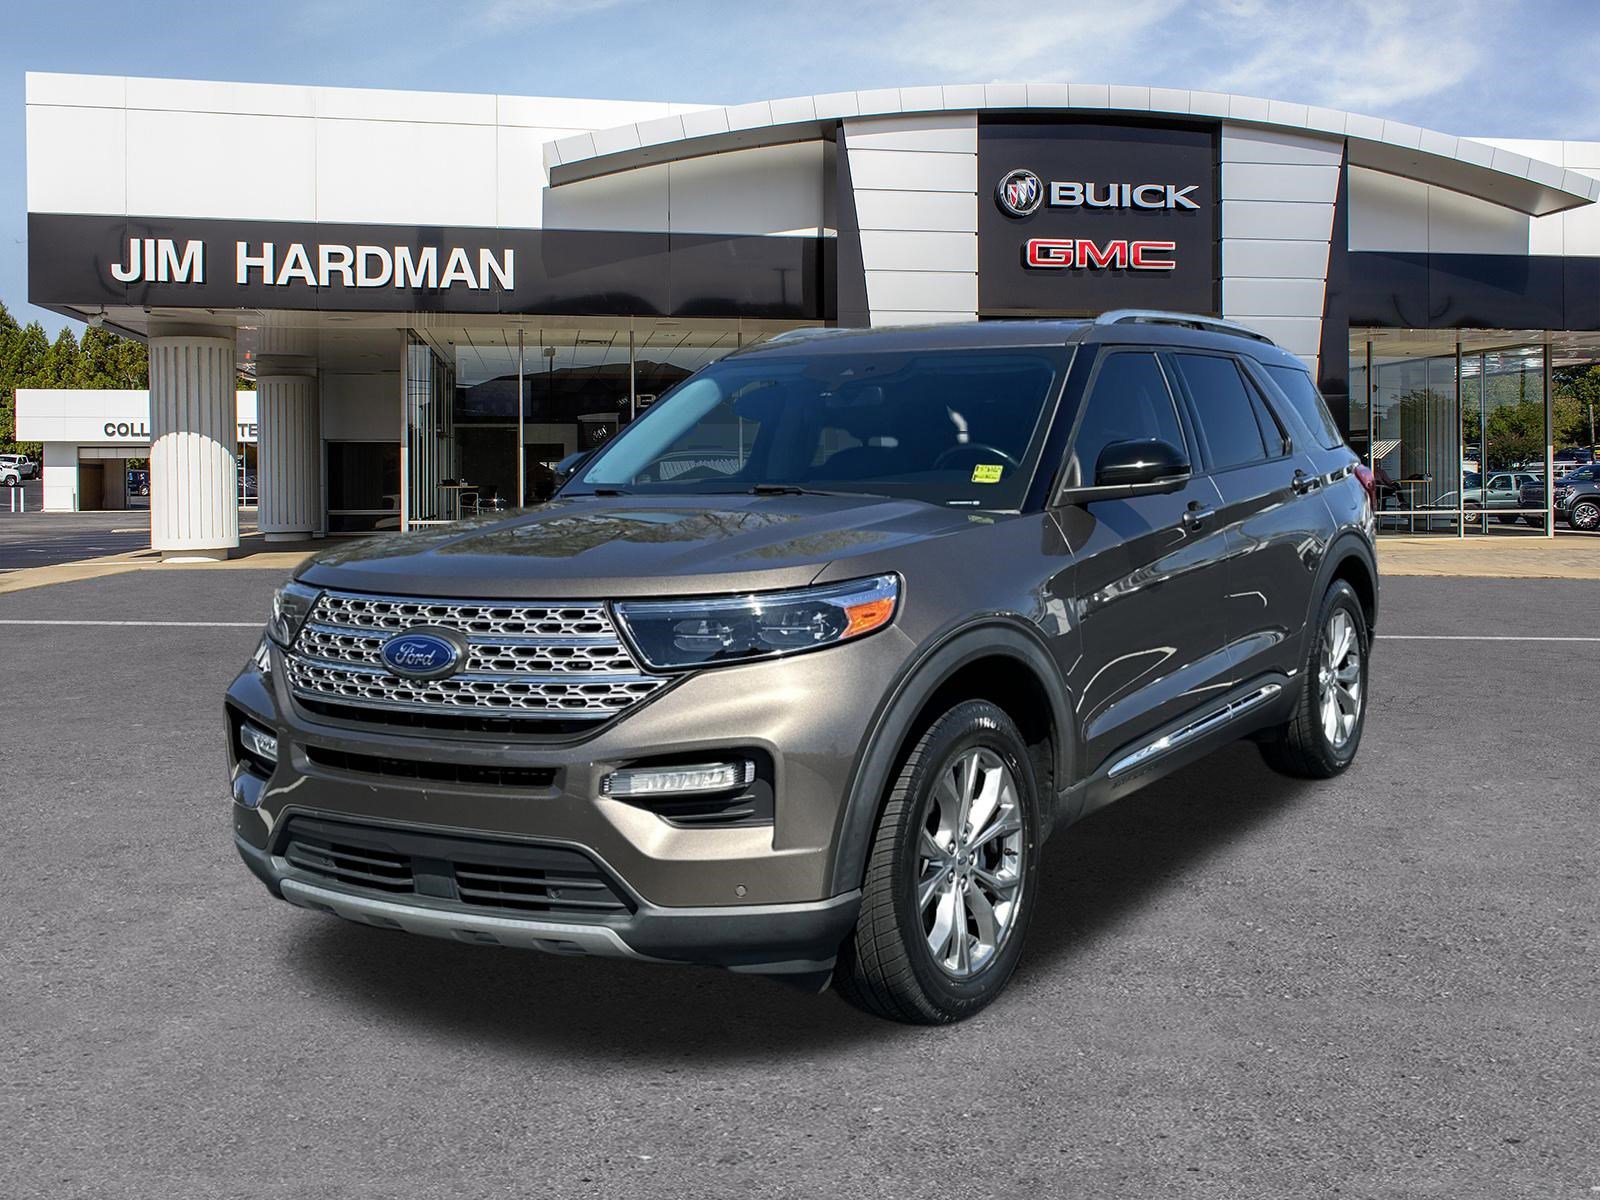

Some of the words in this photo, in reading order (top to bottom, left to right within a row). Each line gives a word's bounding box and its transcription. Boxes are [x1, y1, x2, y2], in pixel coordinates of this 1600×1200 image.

[1050, 181, 1200, 209] BUICK
[111, 238, 205, 283] JIM
[236, 241, 515, 290] HARDMAN
[1026, 238, 1176, 270] GMC
[395, 641, 436, 666] Ford
